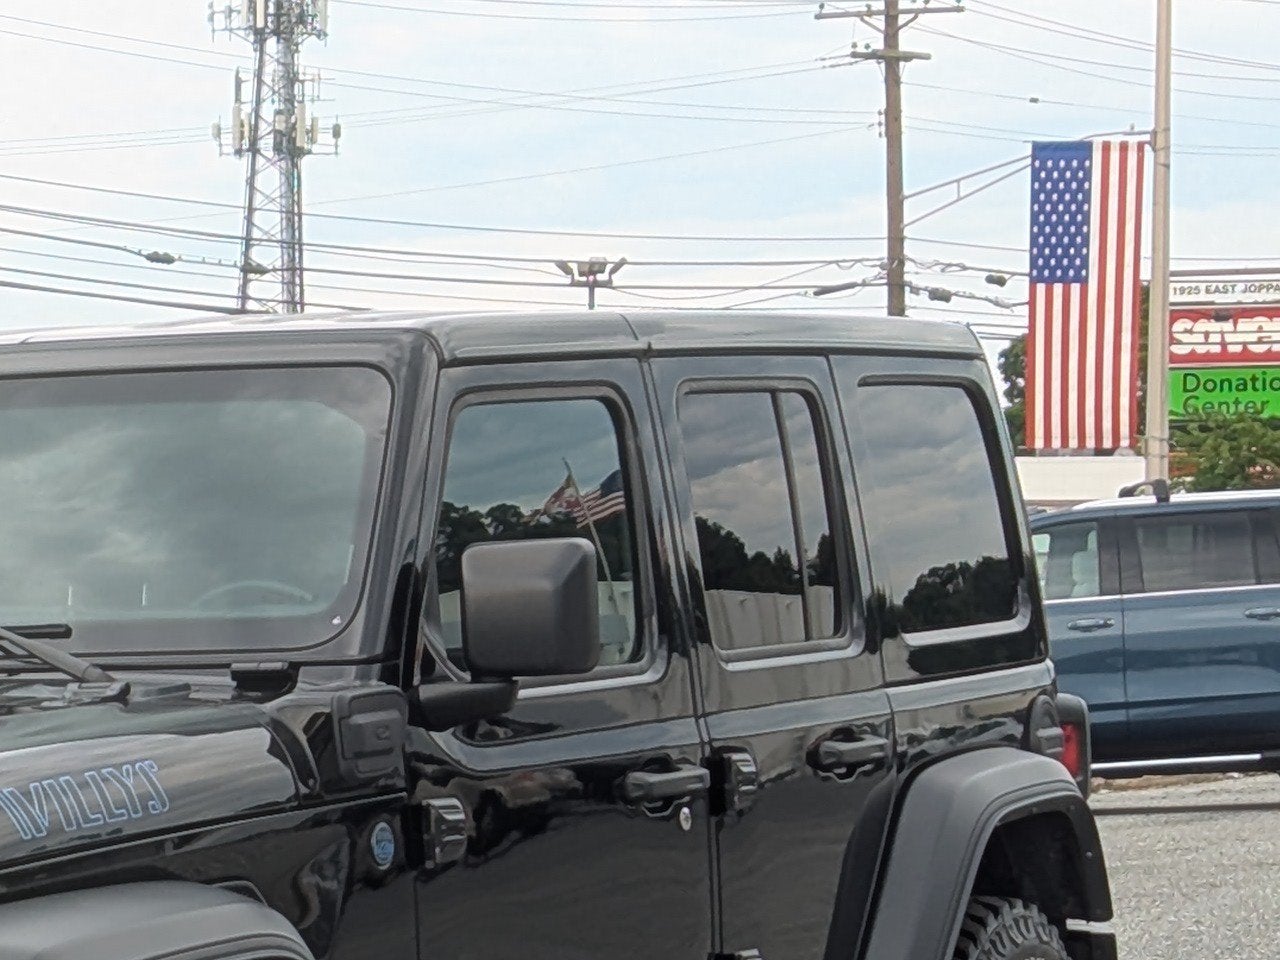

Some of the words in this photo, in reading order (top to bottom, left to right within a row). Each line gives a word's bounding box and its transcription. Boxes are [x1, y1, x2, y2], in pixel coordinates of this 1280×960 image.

[1173, 285, 1201, 296] 1925
[1205, 283, 1238, 295] EAST
[1182, 394, 1270, 416] Center
